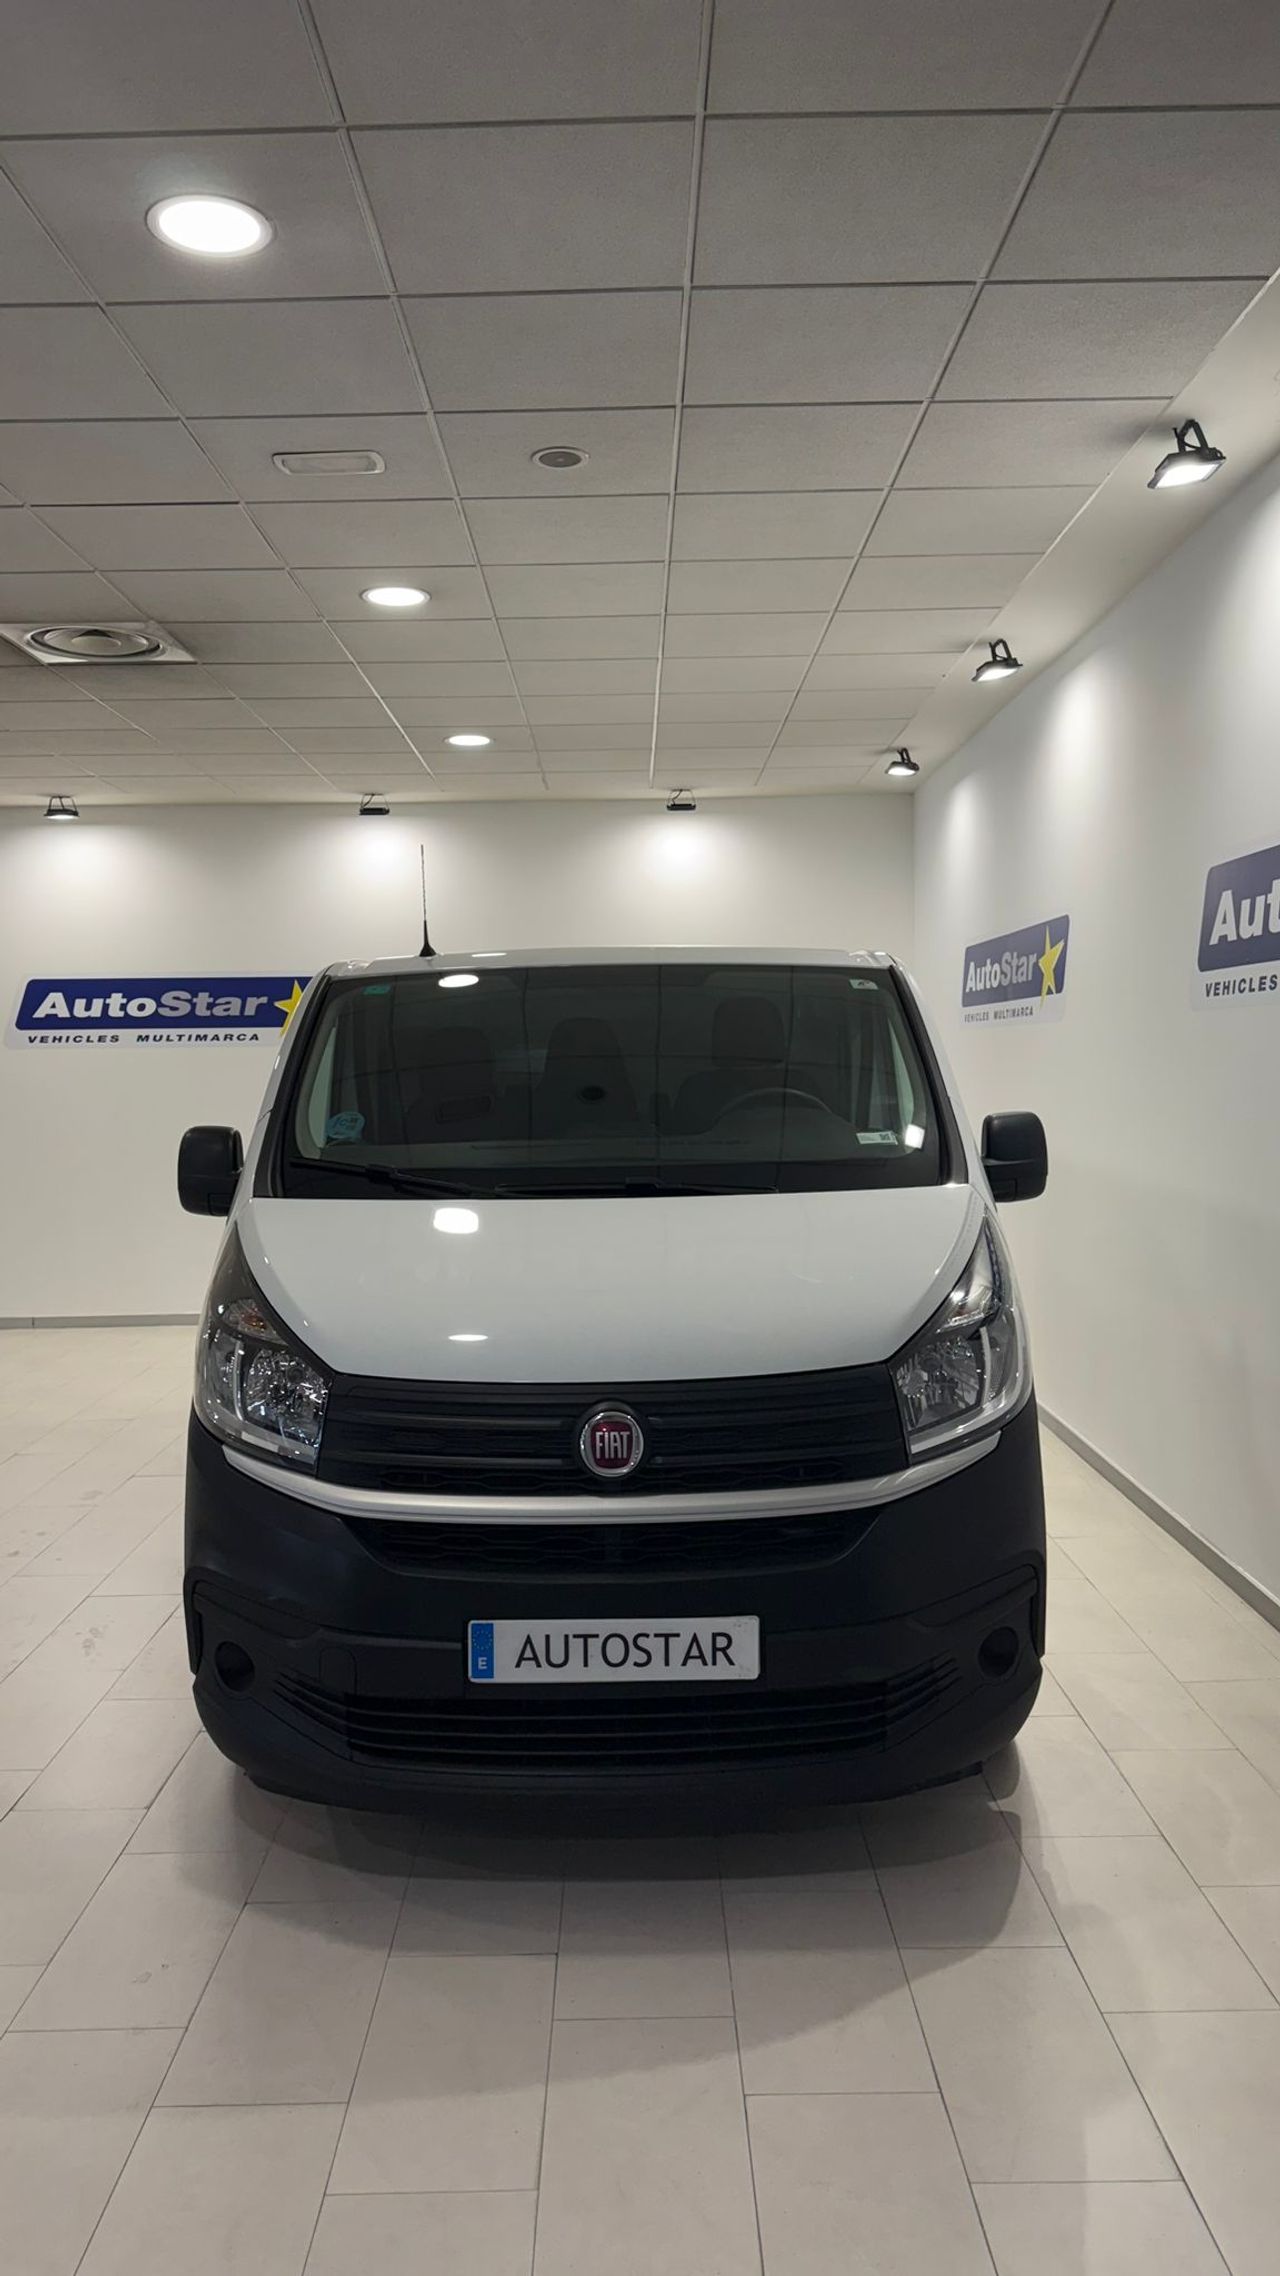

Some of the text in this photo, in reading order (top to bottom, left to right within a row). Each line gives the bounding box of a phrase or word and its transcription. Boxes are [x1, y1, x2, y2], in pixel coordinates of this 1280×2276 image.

[966, 952, 1037, 993] AutoStar
[1206, 974, 1278, 997] VEHICLES
[32, 991, 268, 1018] AutoStar
[964, 1006, 1034, 1023] VEHICLES MULTIMARCA
[28, 1033, 260, 1044] VEHICLES MULTIMARCA
[595, 1431, 630, 1459] FIAT
[477, 1632, 736, 1669] E AUTOSTAR
